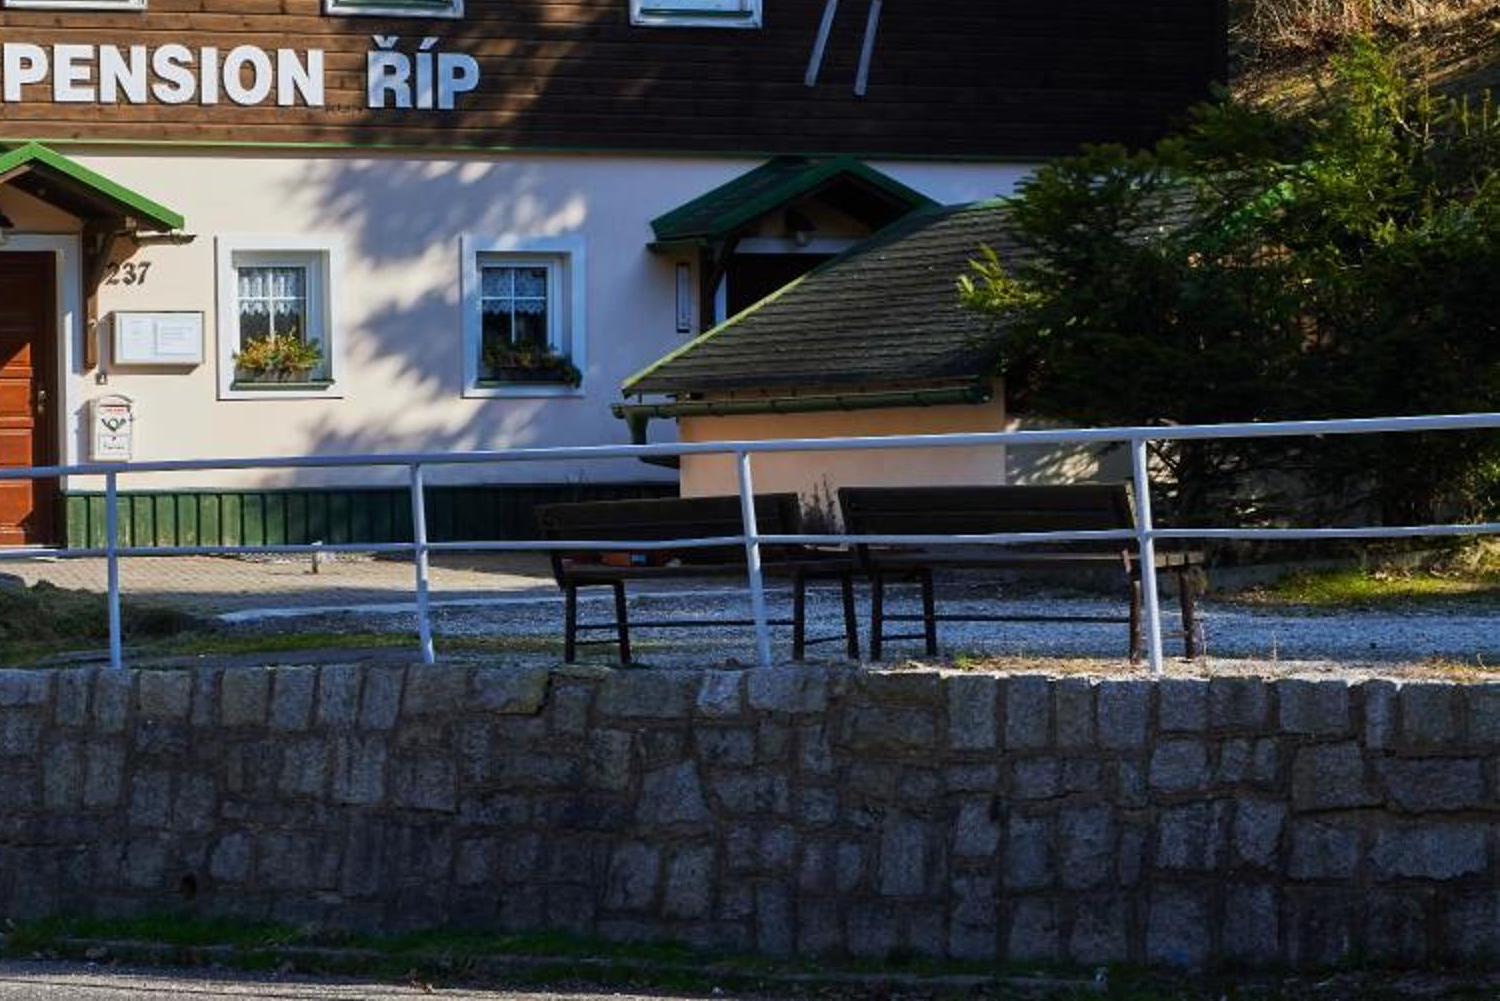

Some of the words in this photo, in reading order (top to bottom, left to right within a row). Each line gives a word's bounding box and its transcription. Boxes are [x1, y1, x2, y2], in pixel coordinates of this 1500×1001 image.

[2, 42, 326, 107] PENSION
[366, 34, 481, 111] ŘÍP
[105, 261, 151, 286] 237
